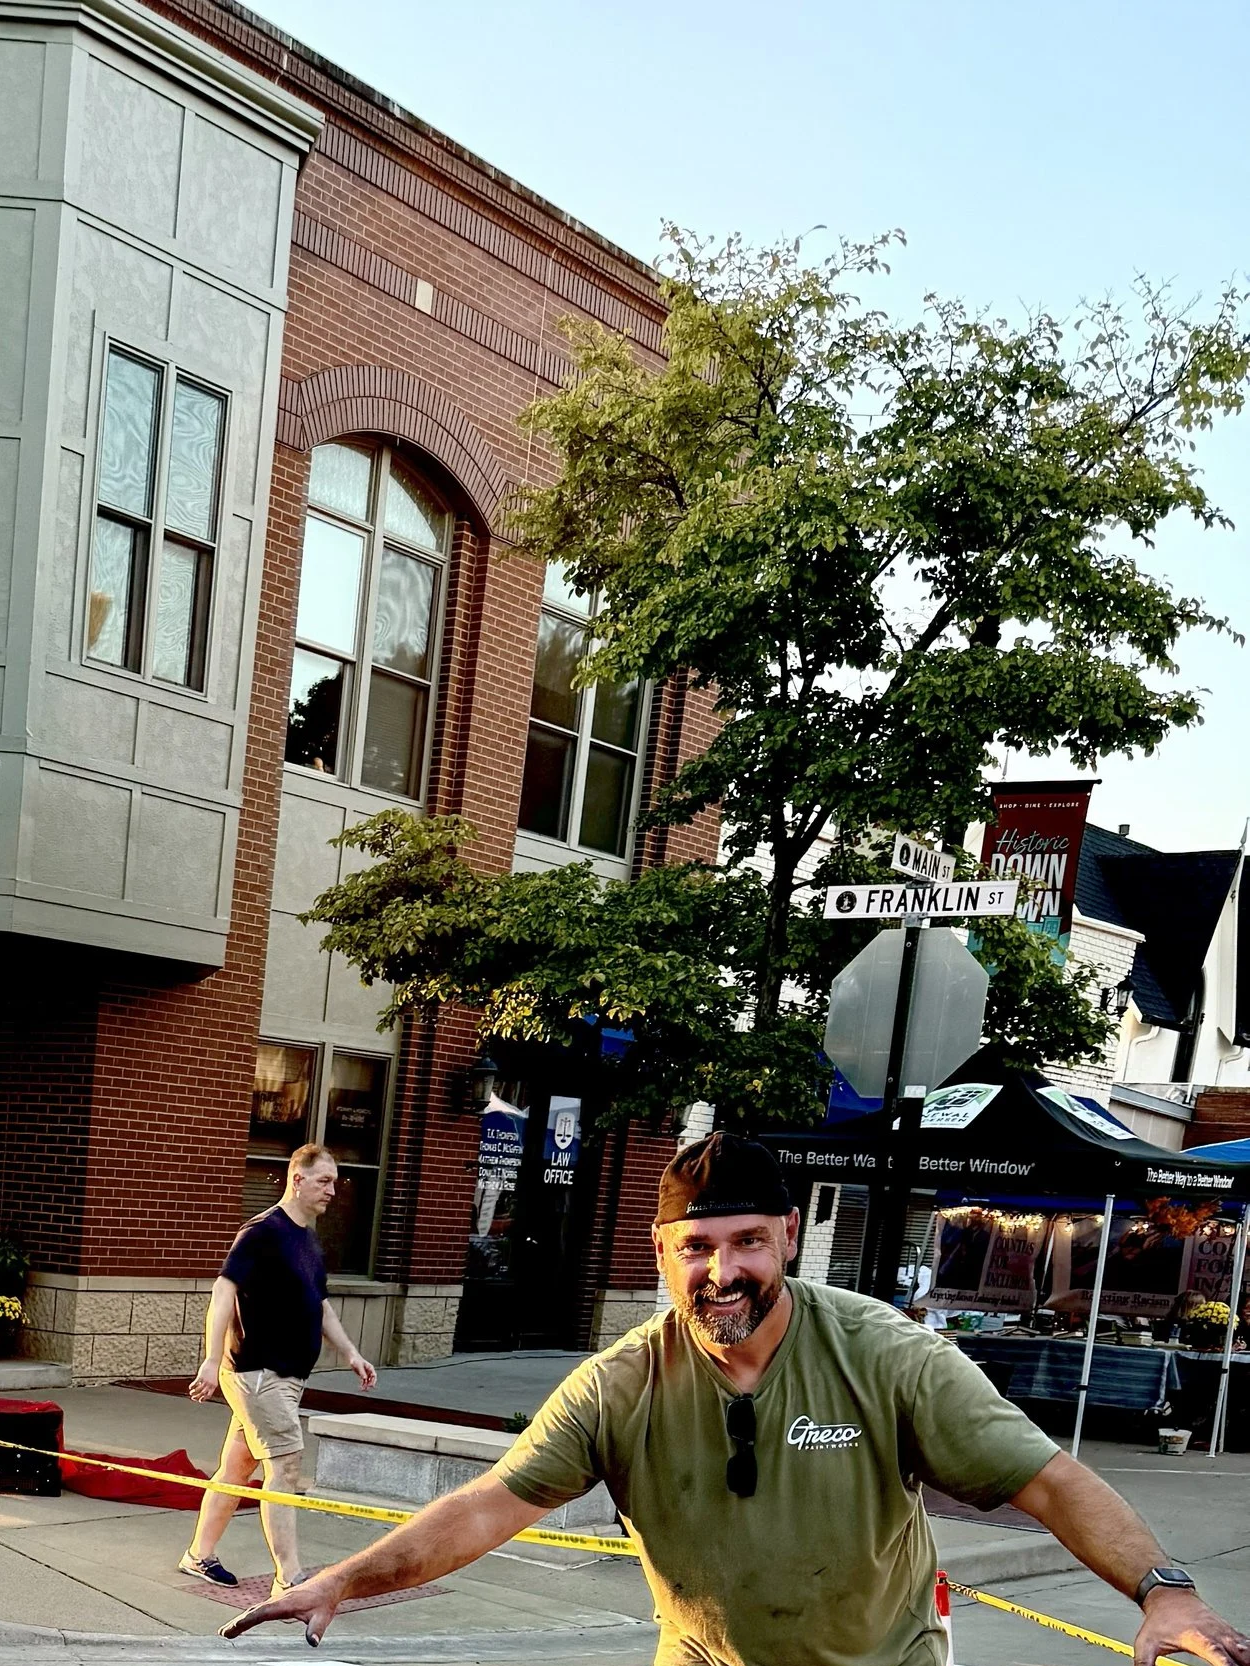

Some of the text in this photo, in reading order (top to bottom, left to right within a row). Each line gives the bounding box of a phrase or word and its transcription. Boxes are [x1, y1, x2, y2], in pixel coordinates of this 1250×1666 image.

[996, 828, 1070, 854] Historic
[912, 847, 950, 879] MAIN ST
[866, 886, 1004, 913] FRANKLIN ST
[551, 1151, 570, 1167] LAW
[778, 1150, 802, 1164] The
[806, 1151, 849, 1167] Better
[853, 1154, 876, 1168] Wa
[919, 1156, 965, 1172] Better
[544, 1168, 574, 1185] OFFICE
[1146, 1168, 1158, 1182] The
[1158, 1169, 1174, 1184] Better
[1174, 1172, 1187, 1188] Way
[1197, 1174, 1213, 1188] Better
[787, 1415, 862, 1450] Greco
[805, 1442, 858, 1450] PAINTWORKS
